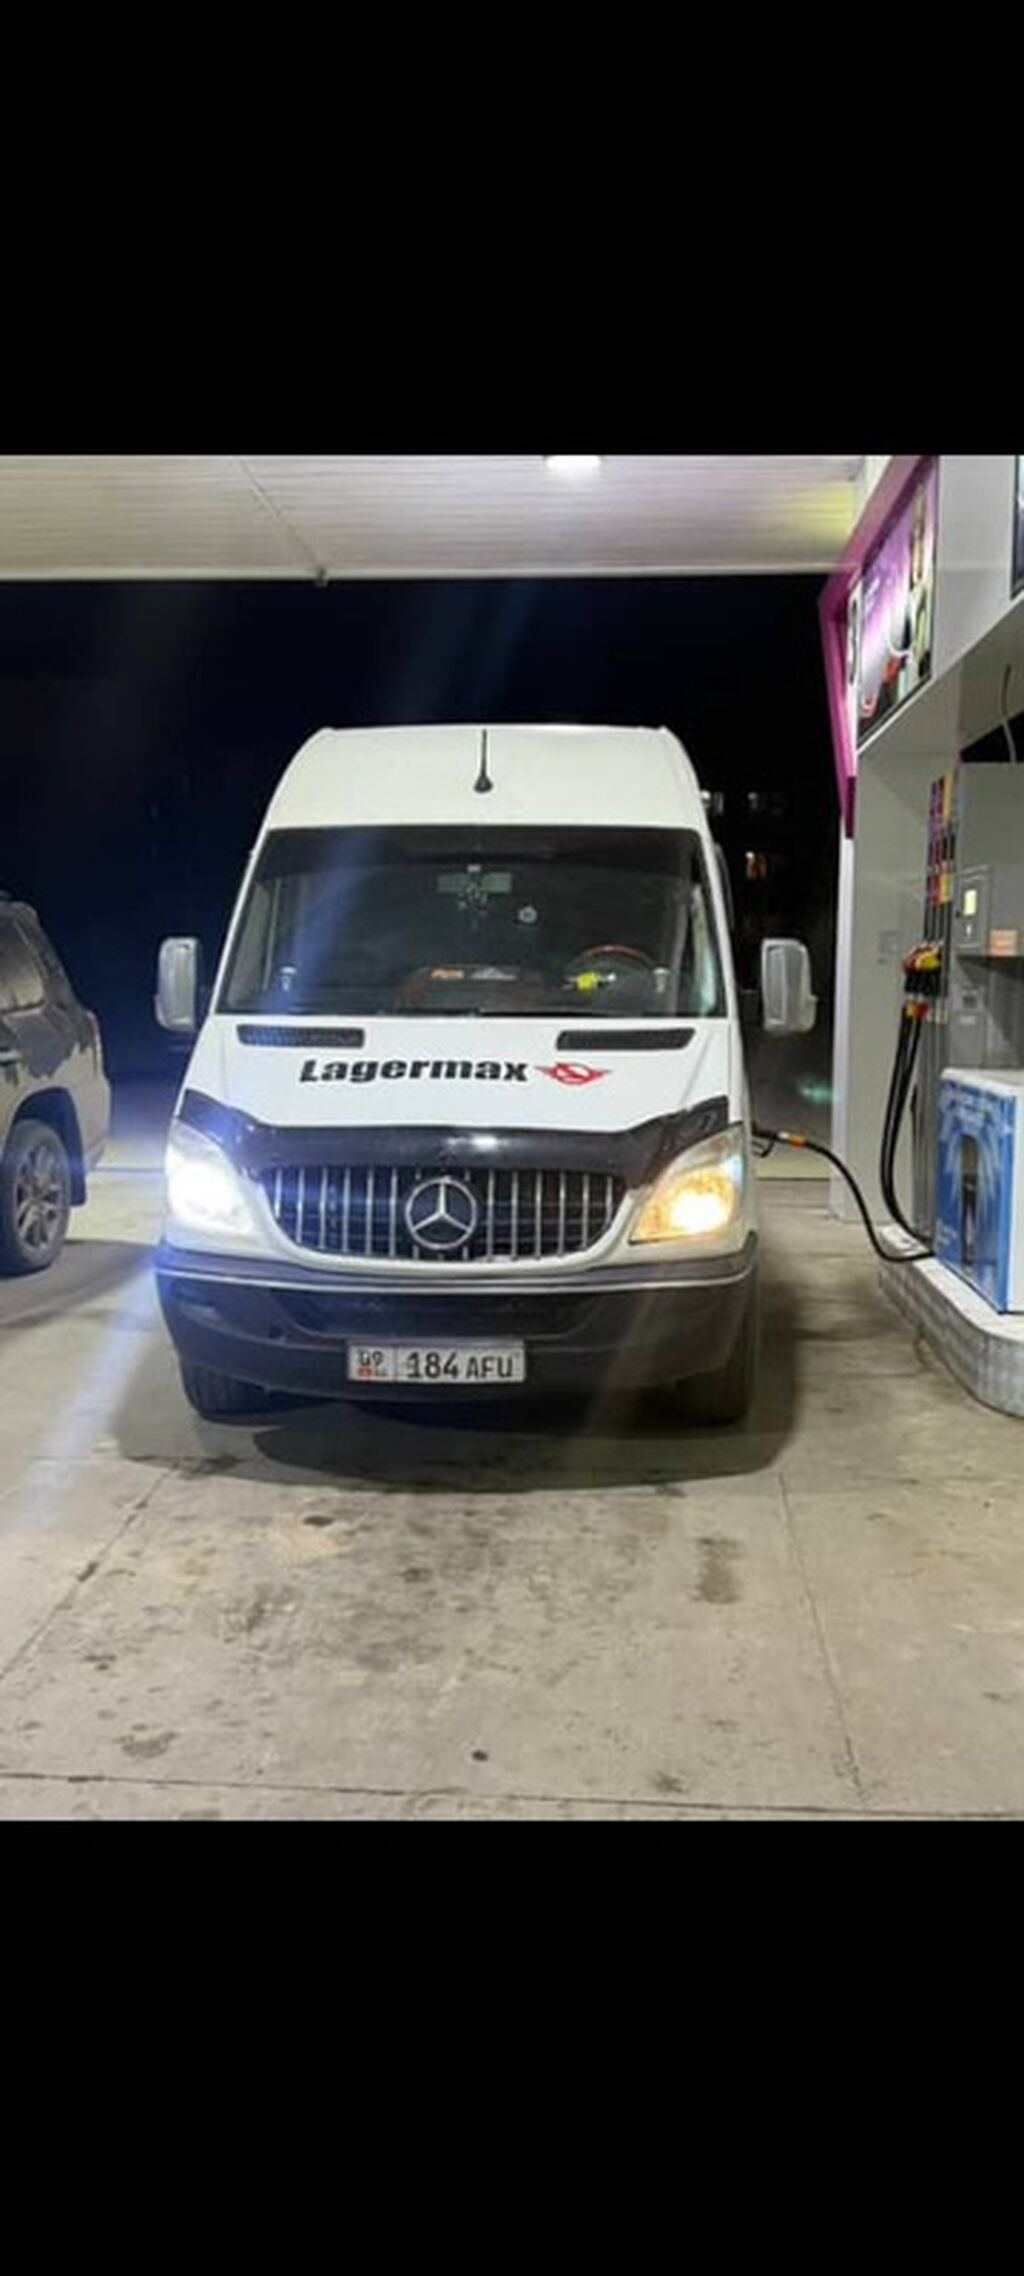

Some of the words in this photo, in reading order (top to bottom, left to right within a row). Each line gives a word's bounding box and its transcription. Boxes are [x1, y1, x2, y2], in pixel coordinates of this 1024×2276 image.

[299, 1059, 528, 1083] Lagermax
[407, 1352, 458, 1379] 184
[466, 1357, 513, 1379] AFU
